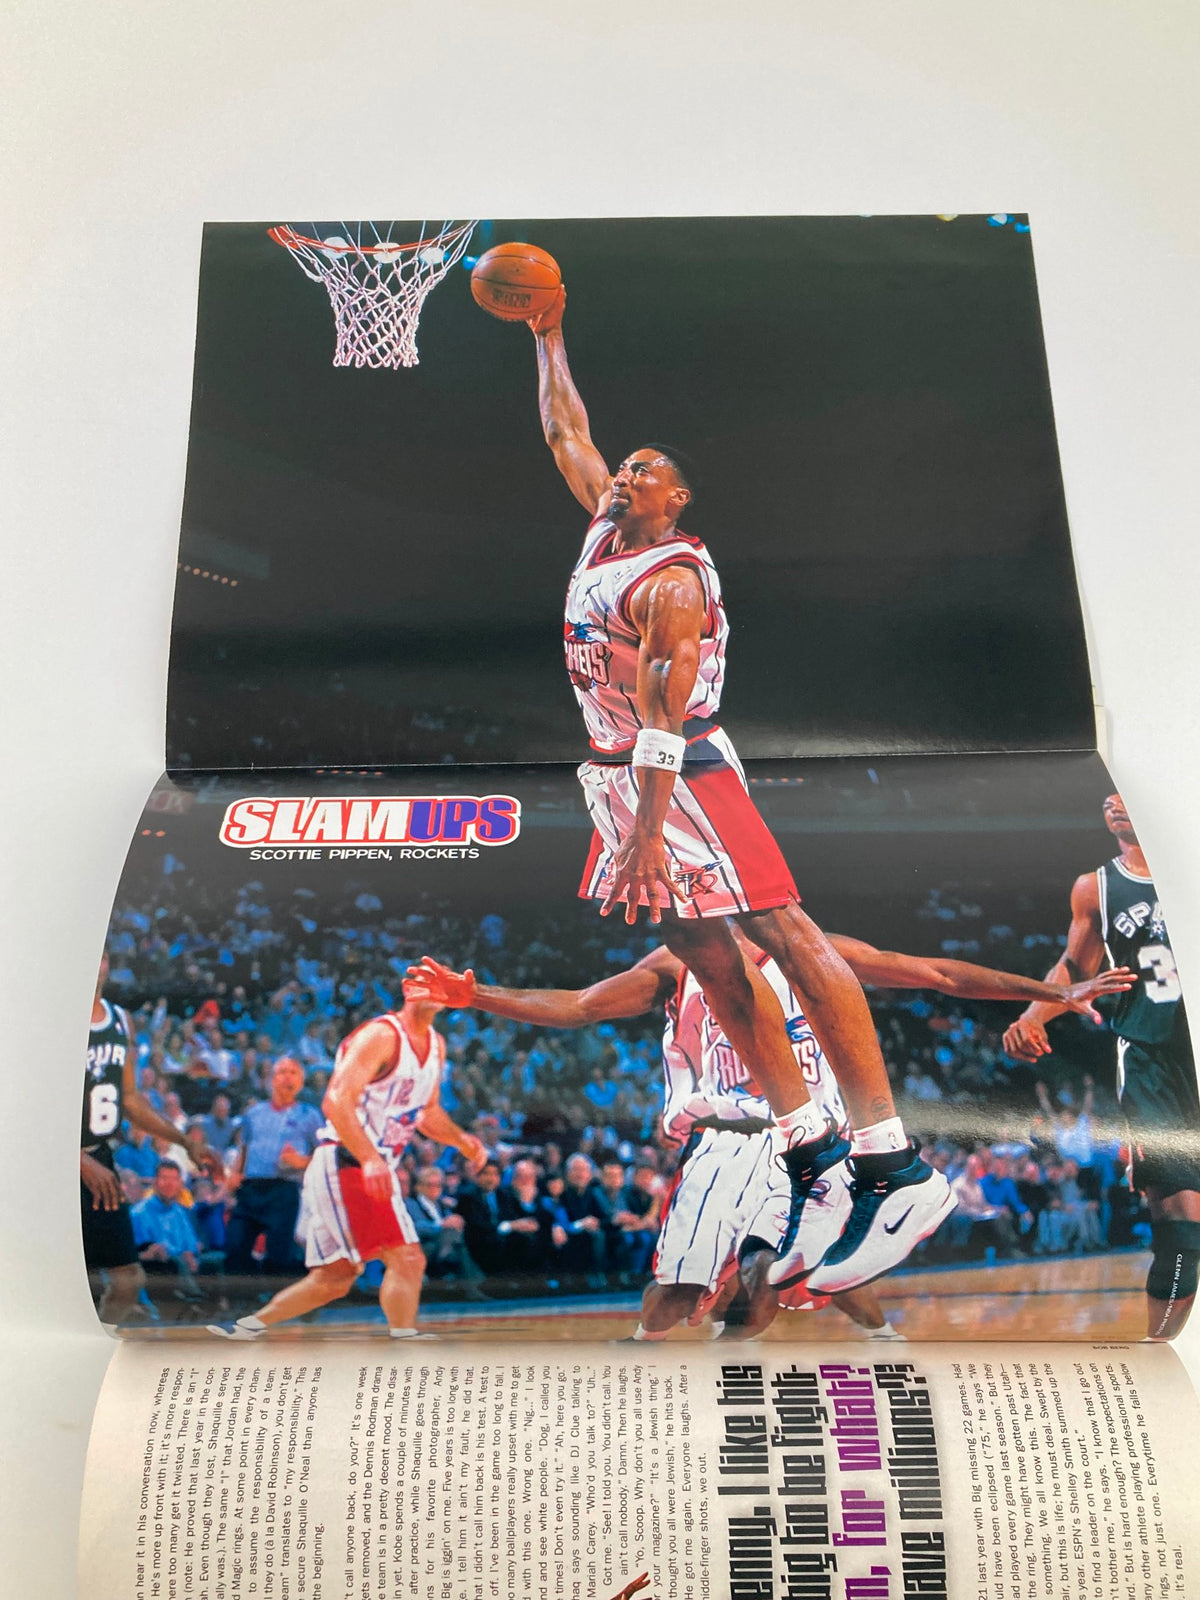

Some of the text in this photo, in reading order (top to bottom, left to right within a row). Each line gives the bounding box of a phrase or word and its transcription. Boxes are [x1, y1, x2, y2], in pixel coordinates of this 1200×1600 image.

[563, 641, 611, 686] KETS
[656, 751, 675, 766] 33
[249, 847, 480, 861] SCOTTIE PIPPEN, ROCKETS
[1174, 1253, 1183, 1280] GLENN
[263, 1367, 277, 1392] team.
[294, 1367, 307, 1385] This
[464, 1366, 475, 1385] that.
[663, 1376, 673, 1399] back.
[678, 1374, 689, 1395] After
[716, 1365, 765, 1405] his
[462, 1390, 472, 1404] did
[1005, 1394, 1020, 1415] past
[259, 1409, 269, 1420] of
[461, 1410, 471, 1422] he
[664, 1402, 674, 1420] hits
[679, 1400, 692, 1436] laughs.
[819, 1364, 882, 1471] what?
[459, 1429, 471, 1456] fault,
[586, 1425, 596, 1445] talk
[664, 1424, 674, 1436] he
[1011, 1419, 1026, 1453] gotten
[718, 1415, 769, 1474] like
[252, 1426, 268, 1499] responsibility
[360, 1366, 384, 1578] removed, and the Dennis Rodman drama
[424, 1366, 446, 1575] for his favorite photographer, Andy
[460, 1461, 471, 1478] my
[570, 1365, 583, 1574] says sounding like DJ Clue talking to
[587, 1450, 598, 1469] you
[681, 1442, 693, 1492] Everyone
[1017, 1456, 1028, 1482] have
[1105, 1363, 1152, 1579] other athlete playing professional sports.
[134, 1368, 170, 1587] hear it in his conversation now, whereas
[183, 1367, 216, 1593] (note: He proved that last year in the con-
[408, 1366, 431, 1595] after practice, while Shaquille goes through
[505, 1366, 522, 1589] many ballplayers really upset with me to get
[770, 1364, 838, 1600] big to be fight-
[951, 1364, 988, 1583] last year with Big missing 22 games. Had
[1083, 1471, 1093, 1489] the
[282, 1495, 293, 1507] to
[457, 1484, 468, 1508] ain't
[668, 1488, 676, 1515] were
[717, 1485, 770, 1495] I
[1019, 1486, 1032, 1518] might
[1086, 1493, 1096, 1507] on
[249, 1506, 260, 1524] the
[666, 1518, 677, 1531] all
[682, 1499, 695, 1532] again.
[832, 1489, 887, 1546] for
[280, 1511, 292, 1567] translates
[457, 1529, 467, 1549] him
[586, 1522, 598, 1555] Carey.
[1023, 1521, 1035, 1548] They
[1088, 1511, 1100, 1547] leader
[249, 1531, 259, 1575] assume
[668, 1535, 679, 1554] you
[685, 1538, 693, 1556] me
[311, 1523, 325, 1600] the beginning.
[457, 1556, 467, 1573] tell
[684, 1561, 696, 1580] got
[1025, 1552, 1037, 1576] ring.
[1091, 1562, 1102, 1583] find
[248, 1582, 258, 1593] to
[586, 1561, 597, 1598] Mariah
[667, 1557, 680, 1599] thought
[1027, 1580, 1038, 1599] the
[683, 1585, 694, 1600] He
[1094, 1587, 1104, 1598] to
